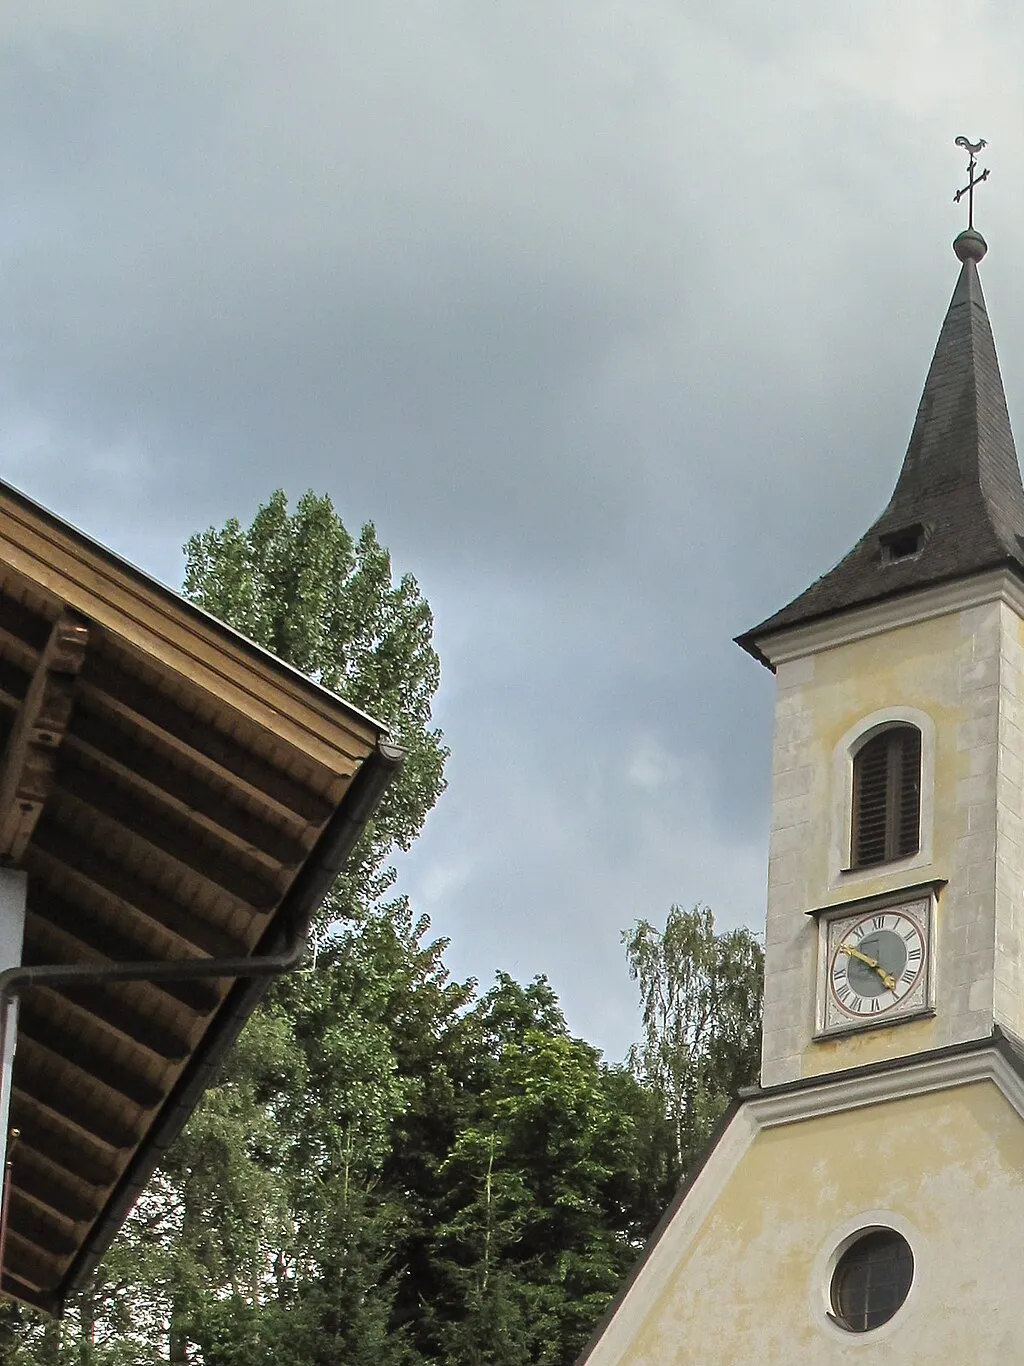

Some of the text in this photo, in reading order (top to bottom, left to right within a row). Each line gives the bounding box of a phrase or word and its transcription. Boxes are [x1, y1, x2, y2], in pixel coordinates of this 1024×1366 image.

[872, 915, 885, 931] XII
[893, 917, 901, 930] I
[852, 926, 865, 939] XI
[904, 928, 917, 942] II
[909, 948, 921, 961] III
[833, 968, 846, 980] IX
[901, 969, 917, 985] IIII
[836, 984, 851, 1003] VIII
[849, 995, 862, 1012] VII
[871, 998, 880, 1012] VI
